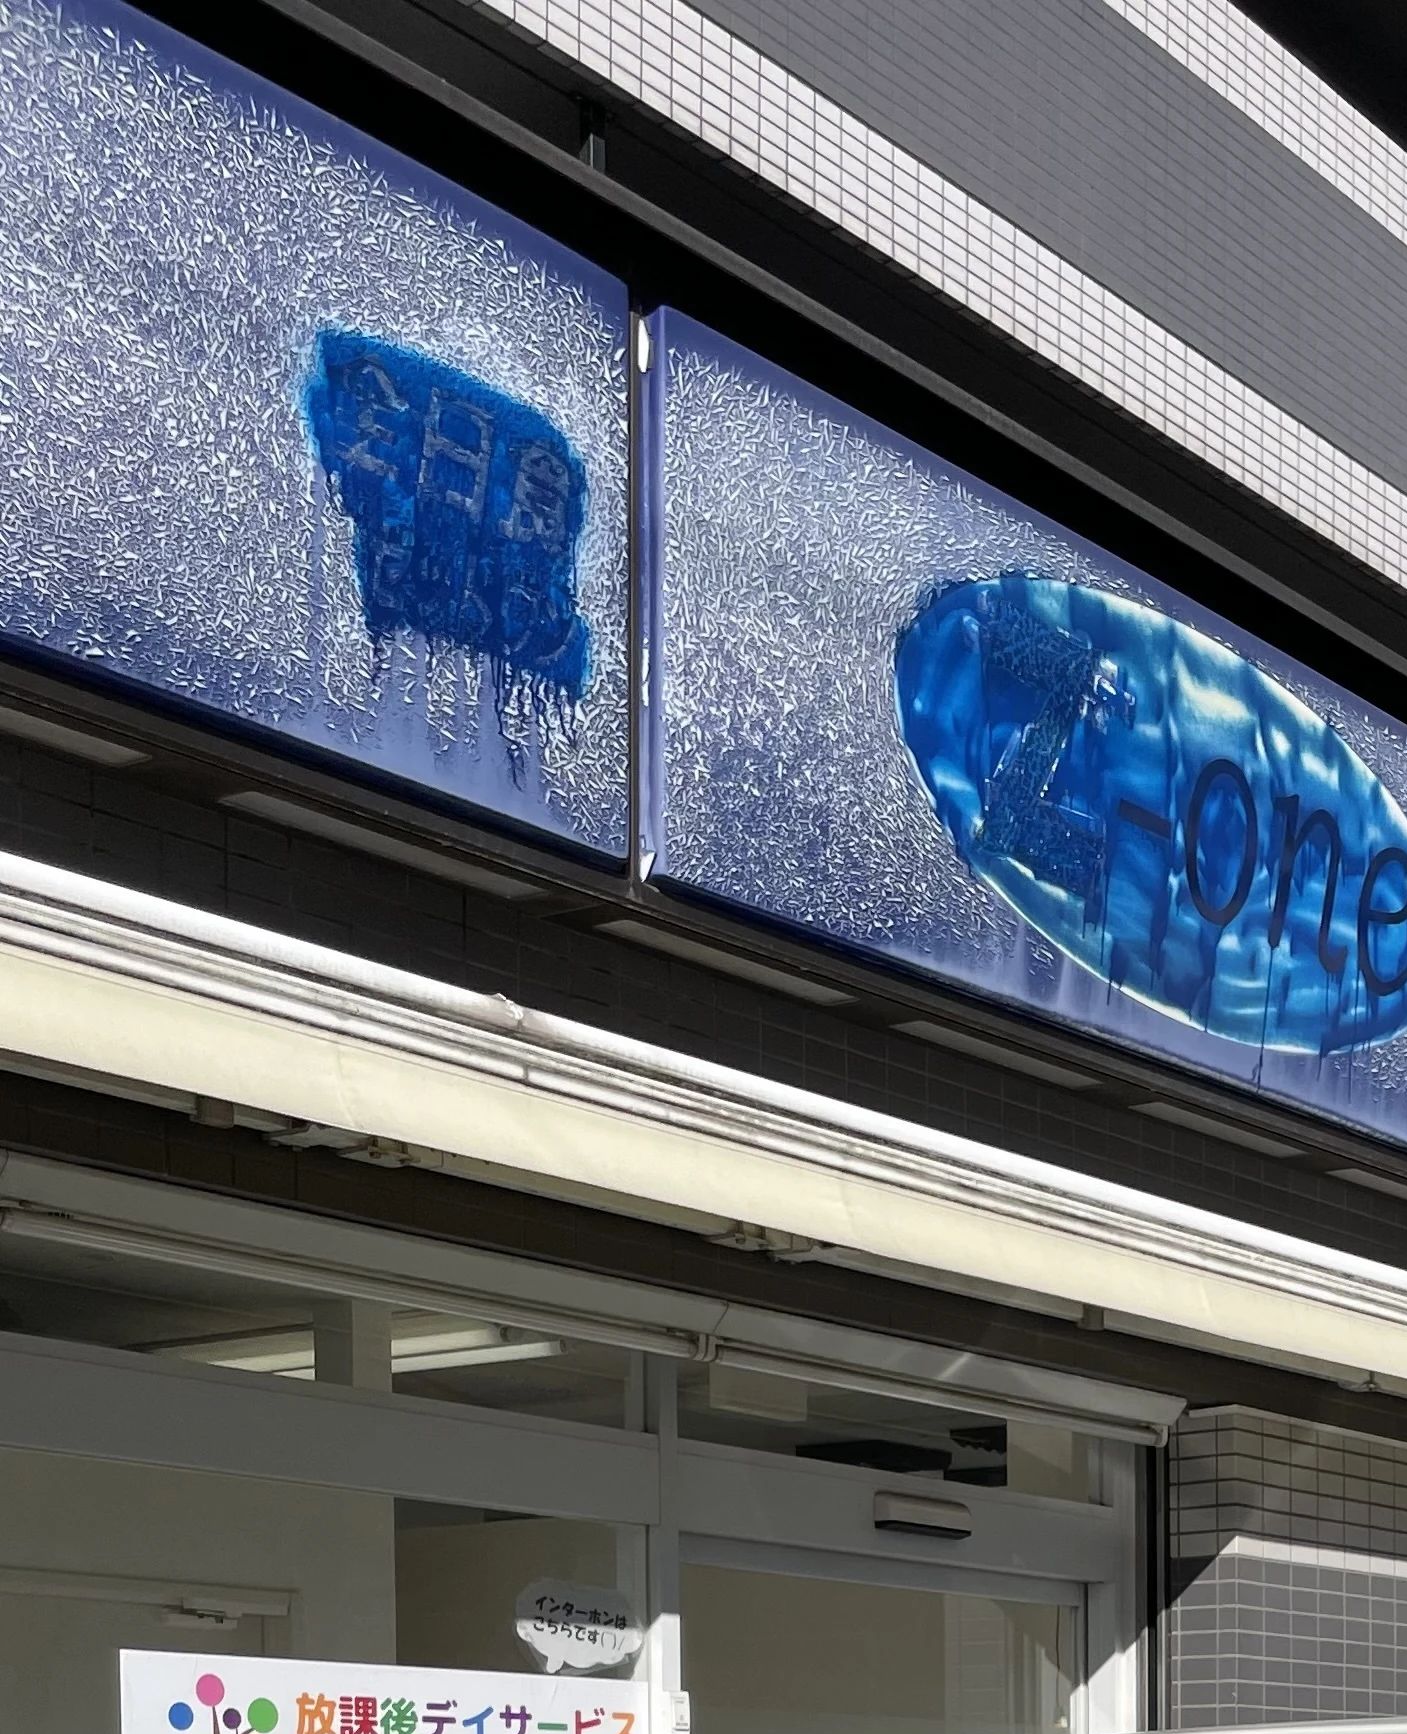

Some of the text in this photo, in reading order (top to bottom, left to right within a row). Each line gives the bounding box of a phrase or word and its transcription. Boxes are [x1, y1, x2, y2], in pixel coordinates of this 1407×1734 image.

[535, 1595, 627, 1631] インターホンは
